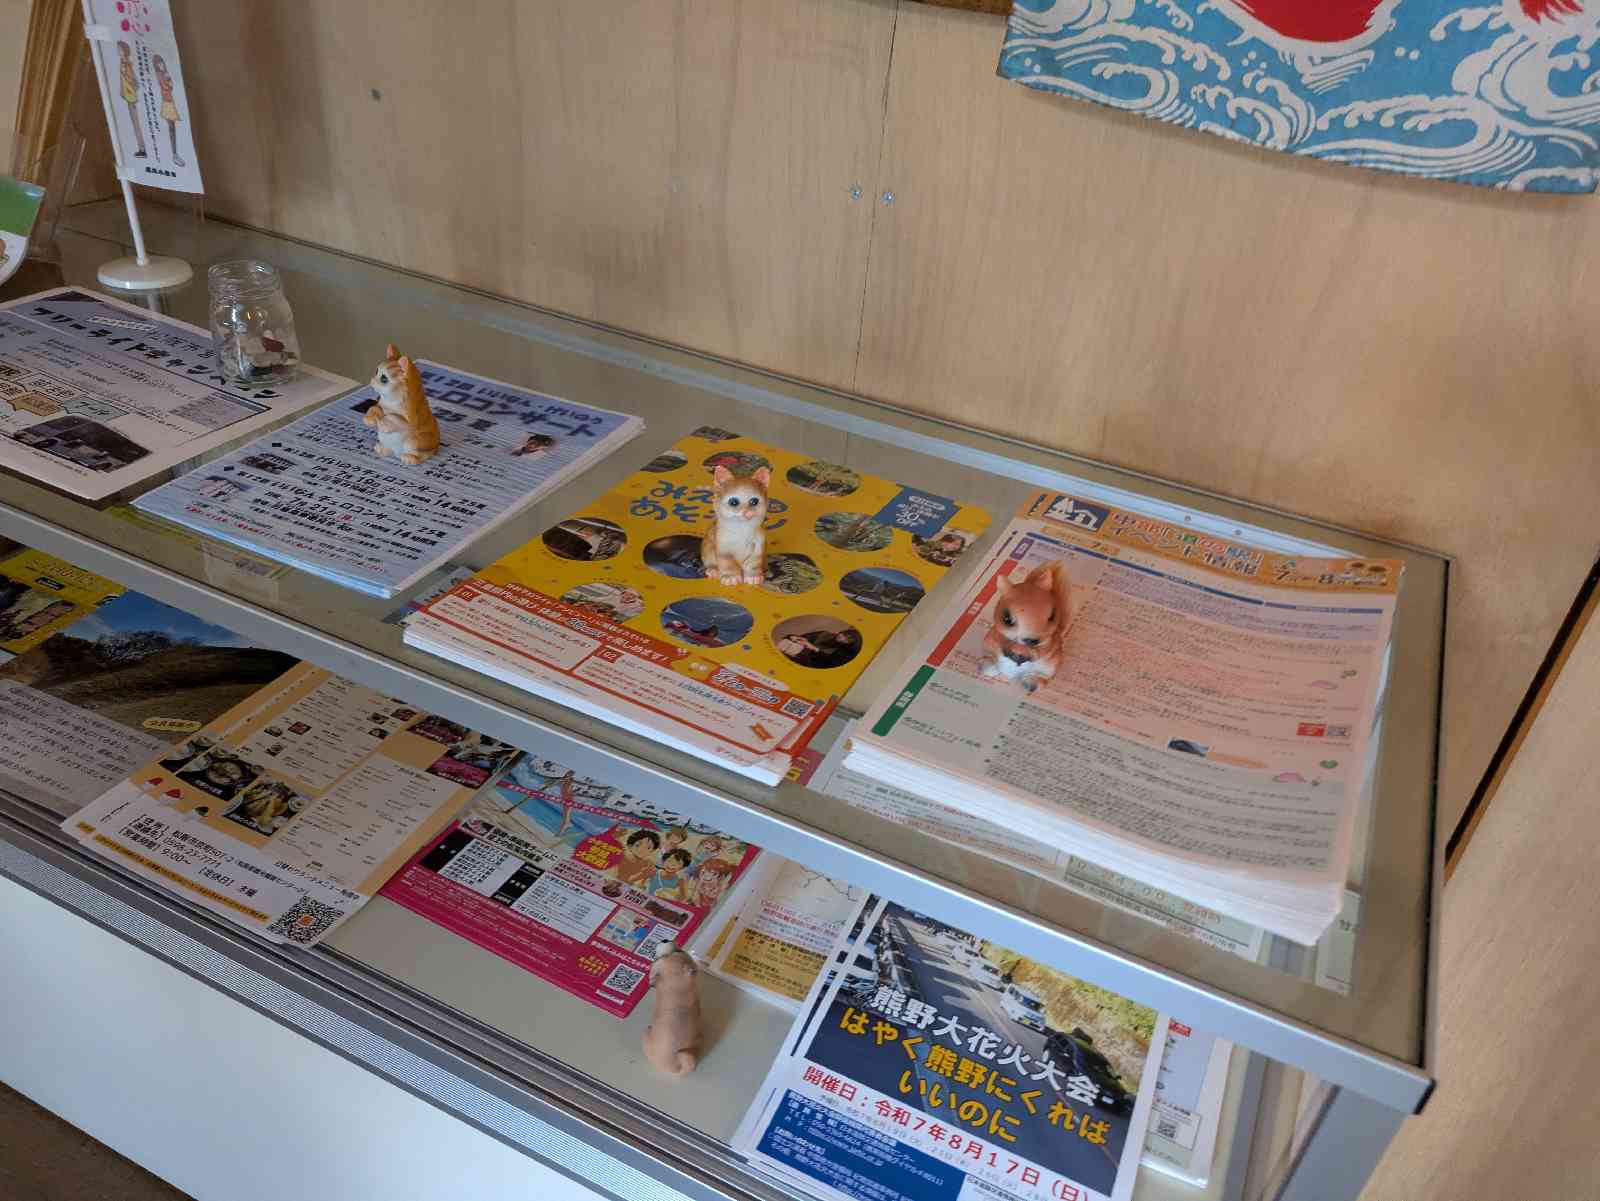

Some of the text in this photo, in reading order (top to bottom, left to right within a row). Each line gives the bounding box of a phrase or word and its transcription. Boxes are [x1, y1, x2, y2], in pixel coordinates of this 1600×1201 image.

[838, 1006, 1112, 1146] はやく熊野にくれば
[898, 1068, 1022, 1144] いいのに
